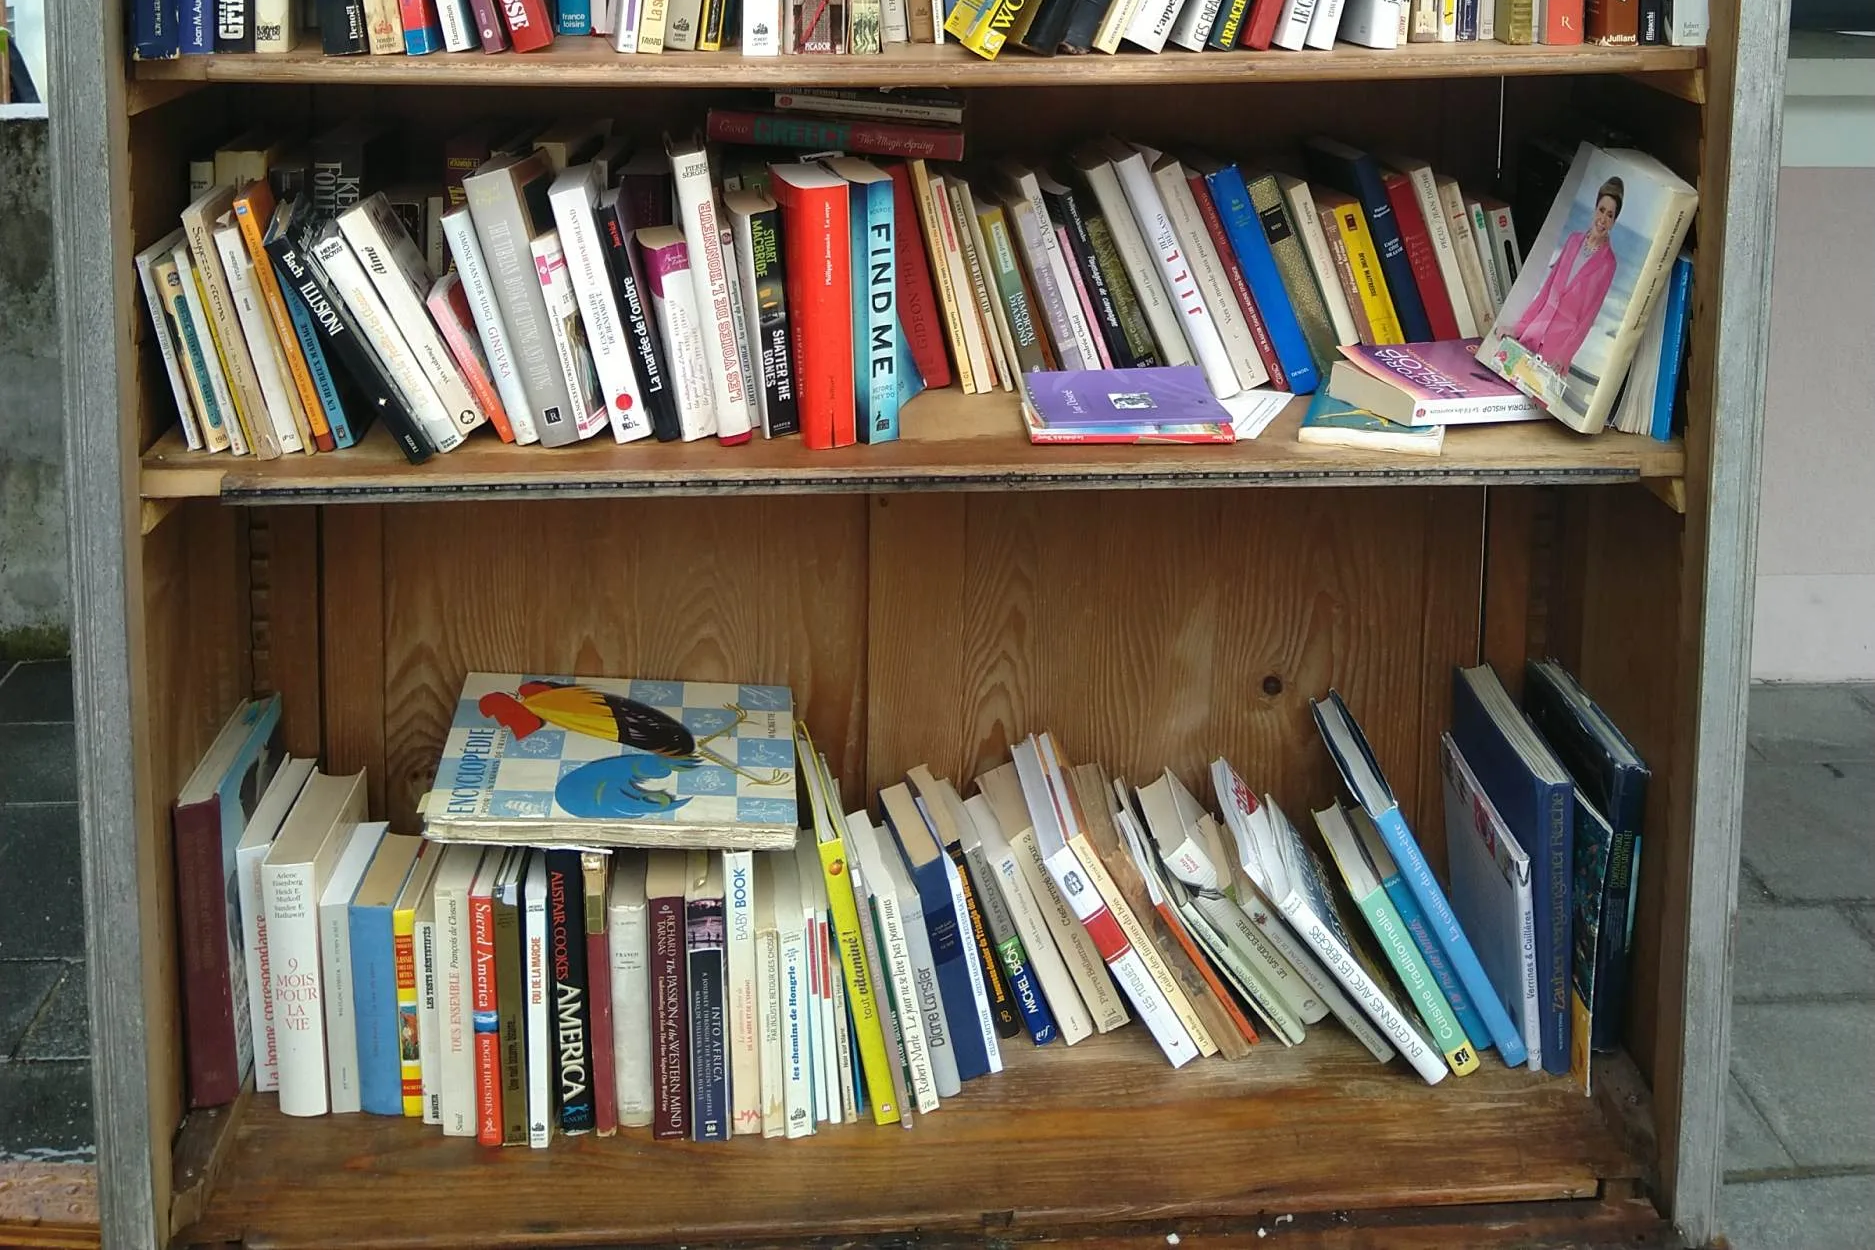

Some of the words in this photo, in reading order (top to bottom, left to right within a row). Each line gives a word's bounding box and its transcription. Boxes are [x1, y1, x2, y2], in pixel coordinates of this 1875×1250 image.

[192, 14, 202, 24] M.
[346, 6, 357, 39] Denoël
[192, 27, 202, 46] Jean
[457, 230, 470, 259] SIMONE
[698, 201, 725, 295] L'HONNEUR
[750, 221, 766, 277] MACBRIDE
[764, 229, 777, 263] STUART
[465, 261, 476, 277] VAN
[871, 223, 891, 320] FIND
[282, 252, 305, 279] Bach
[299, 281, 345, 336] ILLUSIONI
[471, 280, 482, 295] DER
[622, 277, 644, 322] l'ombre
[476, 297, 493, 322] VLUGT
[714, 297, 730, 317] DE
[634, 321, 647, 334] de
[487, 326, 513, 378] GINEVRA
[638, 335, 659, 375] mariée
[718, 322, 739, 370] VOIES
[772, 330, 788, 375] SHATTER
[872, 326, 893, 378] ME
[649, 376, 662, 392] La
[763, 350, 775, 387] BONES
[1375, 350, 1445, 393] VICTORIA
[1384, 349, 1466, 392] HISLOP
[727, 373, 742, 403] LES
[776, 377, 790, 401] THE
[447, 727, 496, 814] ENCYCLOPÉDIE
[733, 868, 746, 908] BOOK
[448, 899, 457, 926] Closets
[735, 911, 747, 940] BABY
[449, 927, 457, 936] de
[658, 921, 666, 955] TARNAS
[667, 915, 676, 956] RICHARD
[1308, 924, 1344, 962] BERGERS
[1374, 907, 1426, 988] traditionnelle
[449, 937, 459, 969] François
[846, 937, 869, 995] vitaminé
[1003, 943, 1029, 977] DÉON
[1337, 957, 1356, 978] LES
[449, 973, 460, 1025] ENSEMBLE
[787, 965, 800, 1006] Hongrie
[1018, 975, 1039, 1014] MICHEL
[1351, 973, 1375, 999] AVEC
[712, 1006, 721, 1037] INTO
[790, 1009, 798, 1019] de
[860, 997, 874, 1020] tout
[1373, 997, 1411, 1042] CEVENNES
[1422, 991, 1453, 1039] Cuisine
[451, 1028, 461, 1053] TOUS
[558, 981, 585, 1101] AMERICA
[790, 1022, 798, 1065] chemins
[905, 1034, 925, 1062] Merle
[1404, 1038, 1424, 1058] EN
[713, 1041, 722, 1082] AFRICA
[792, 1068, 800, 1081] les
[913, 1064, 930, 1094] Robert
